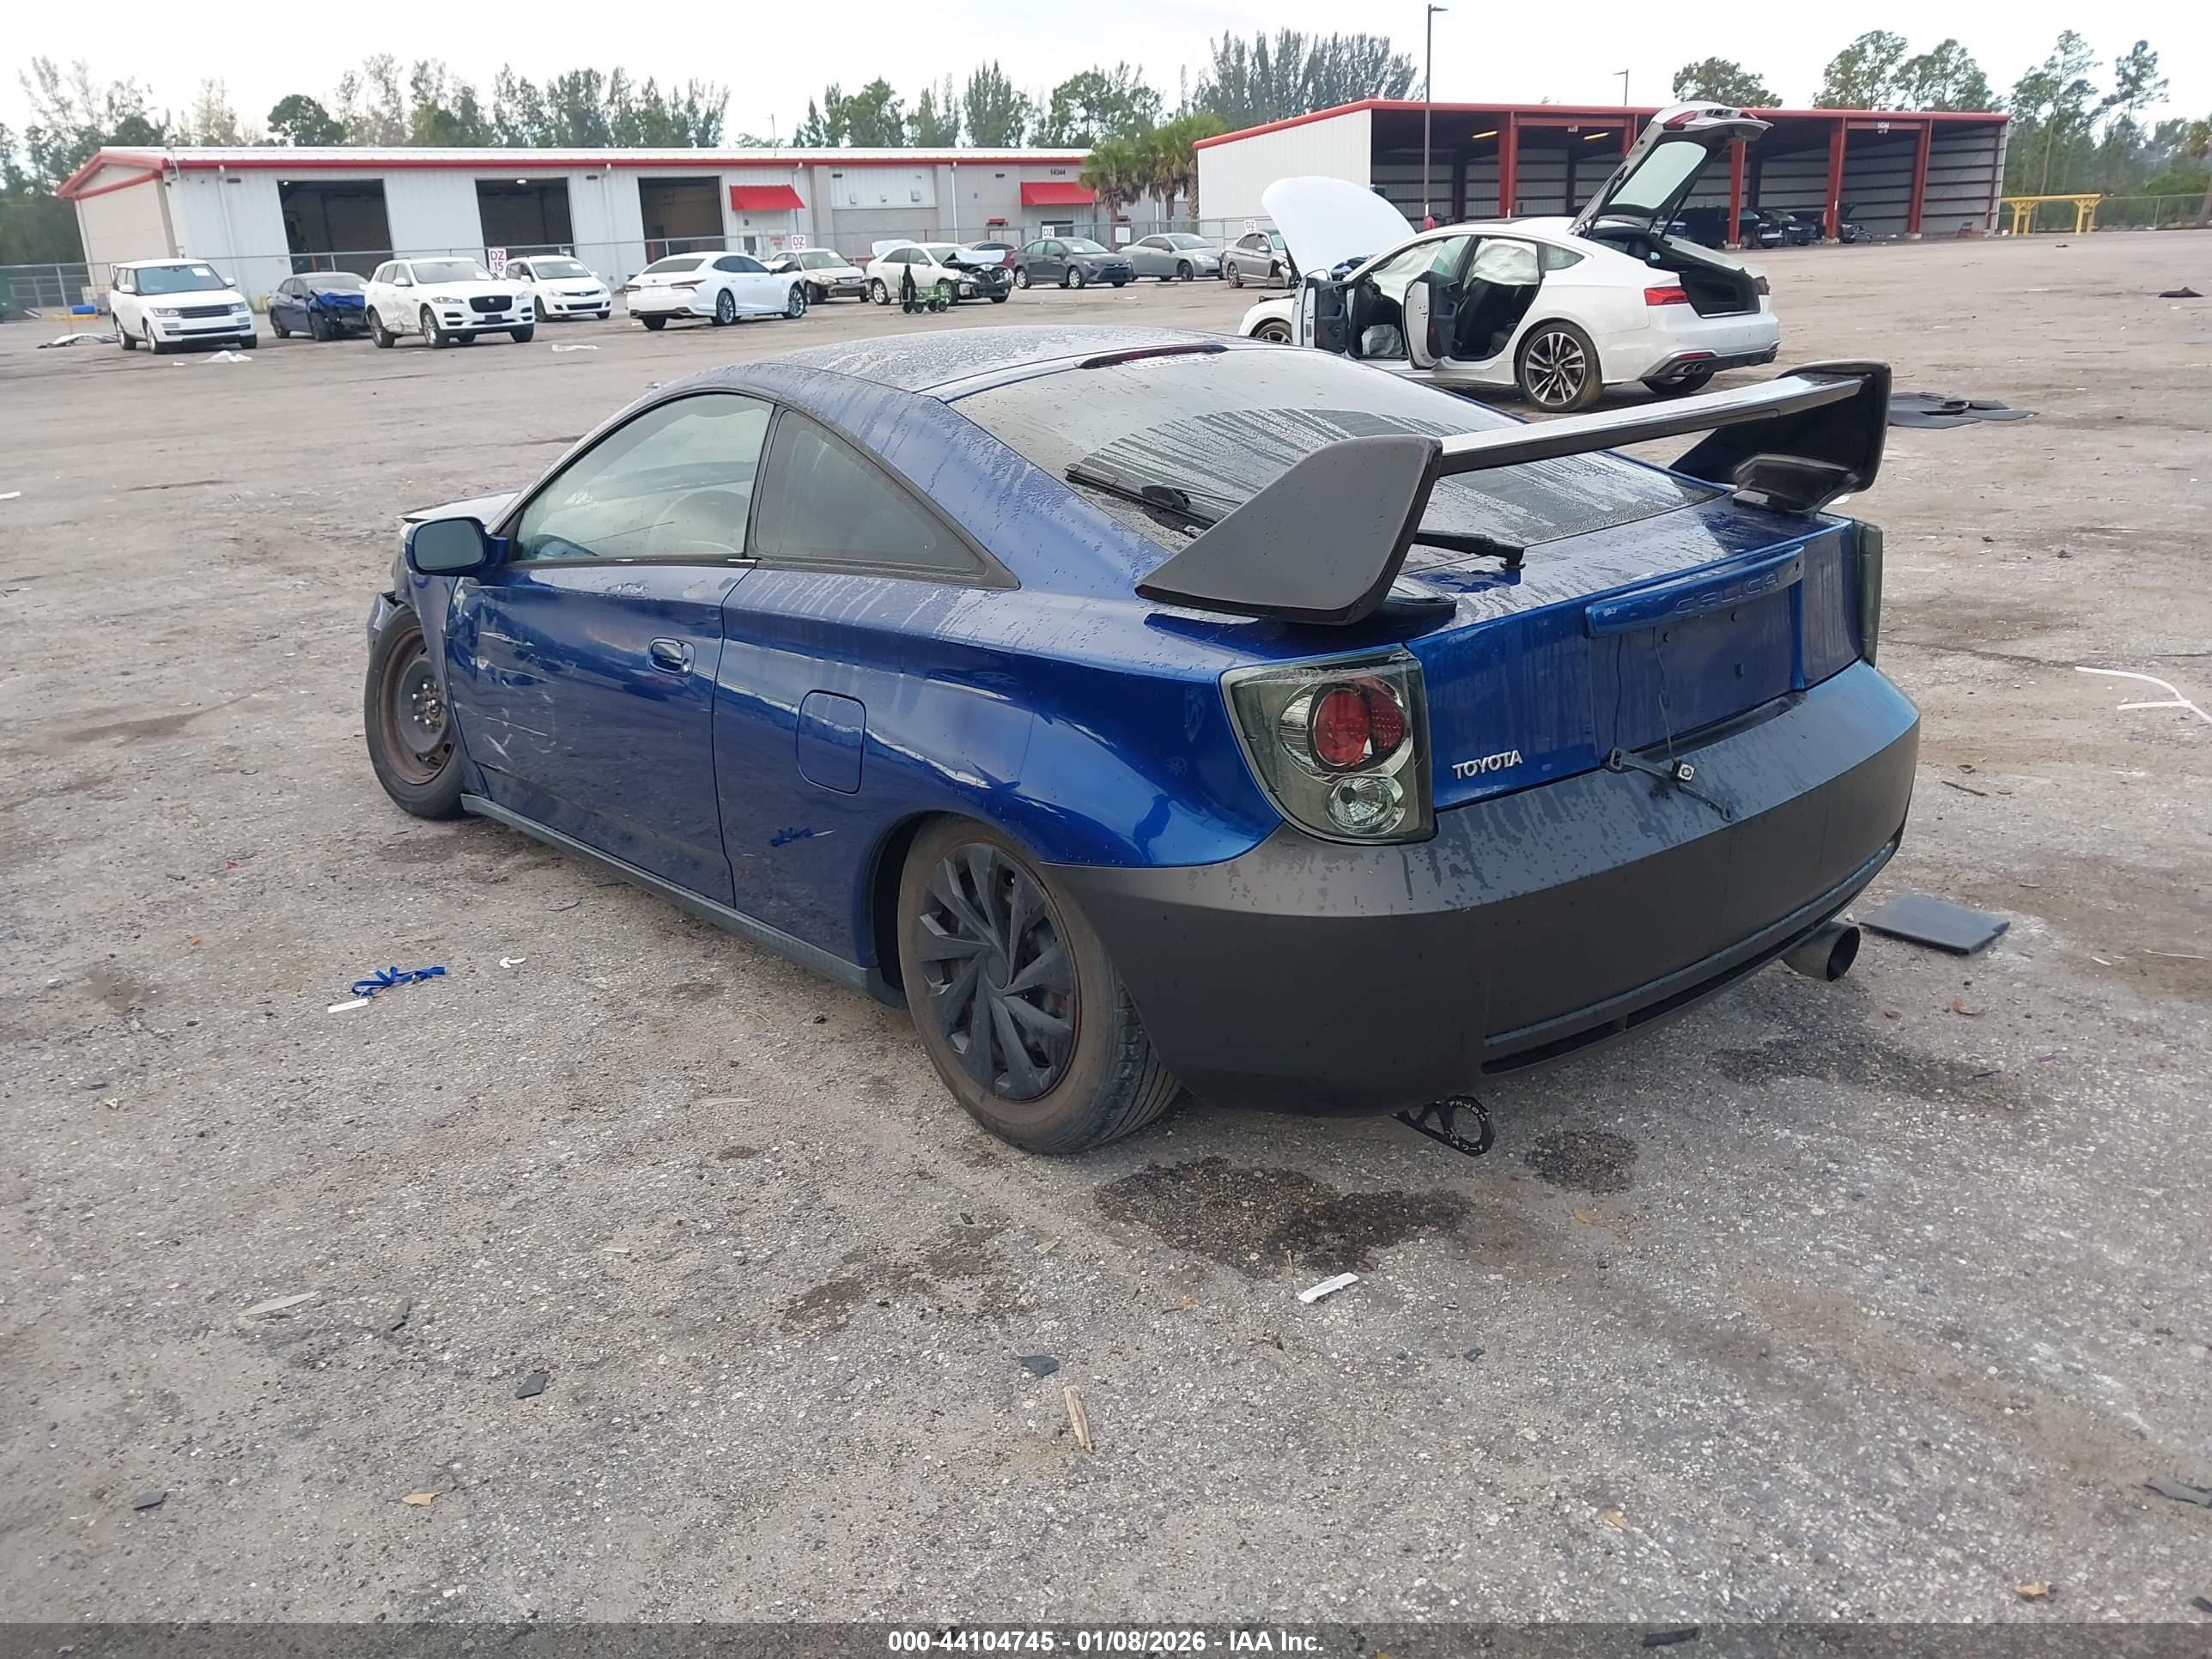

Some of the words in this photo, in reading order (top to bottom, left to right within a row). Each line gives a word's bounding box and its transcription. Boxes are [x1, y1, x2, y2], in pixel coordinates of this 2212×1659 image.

[793, 237, 804, 246] DZ
[490, 251, 505, 261] DZ
[495, 262, 503, 271] 15
[1675, 572, 1779, 614] CELICA
[1451, 750, 1523, 780] TOYOTA
